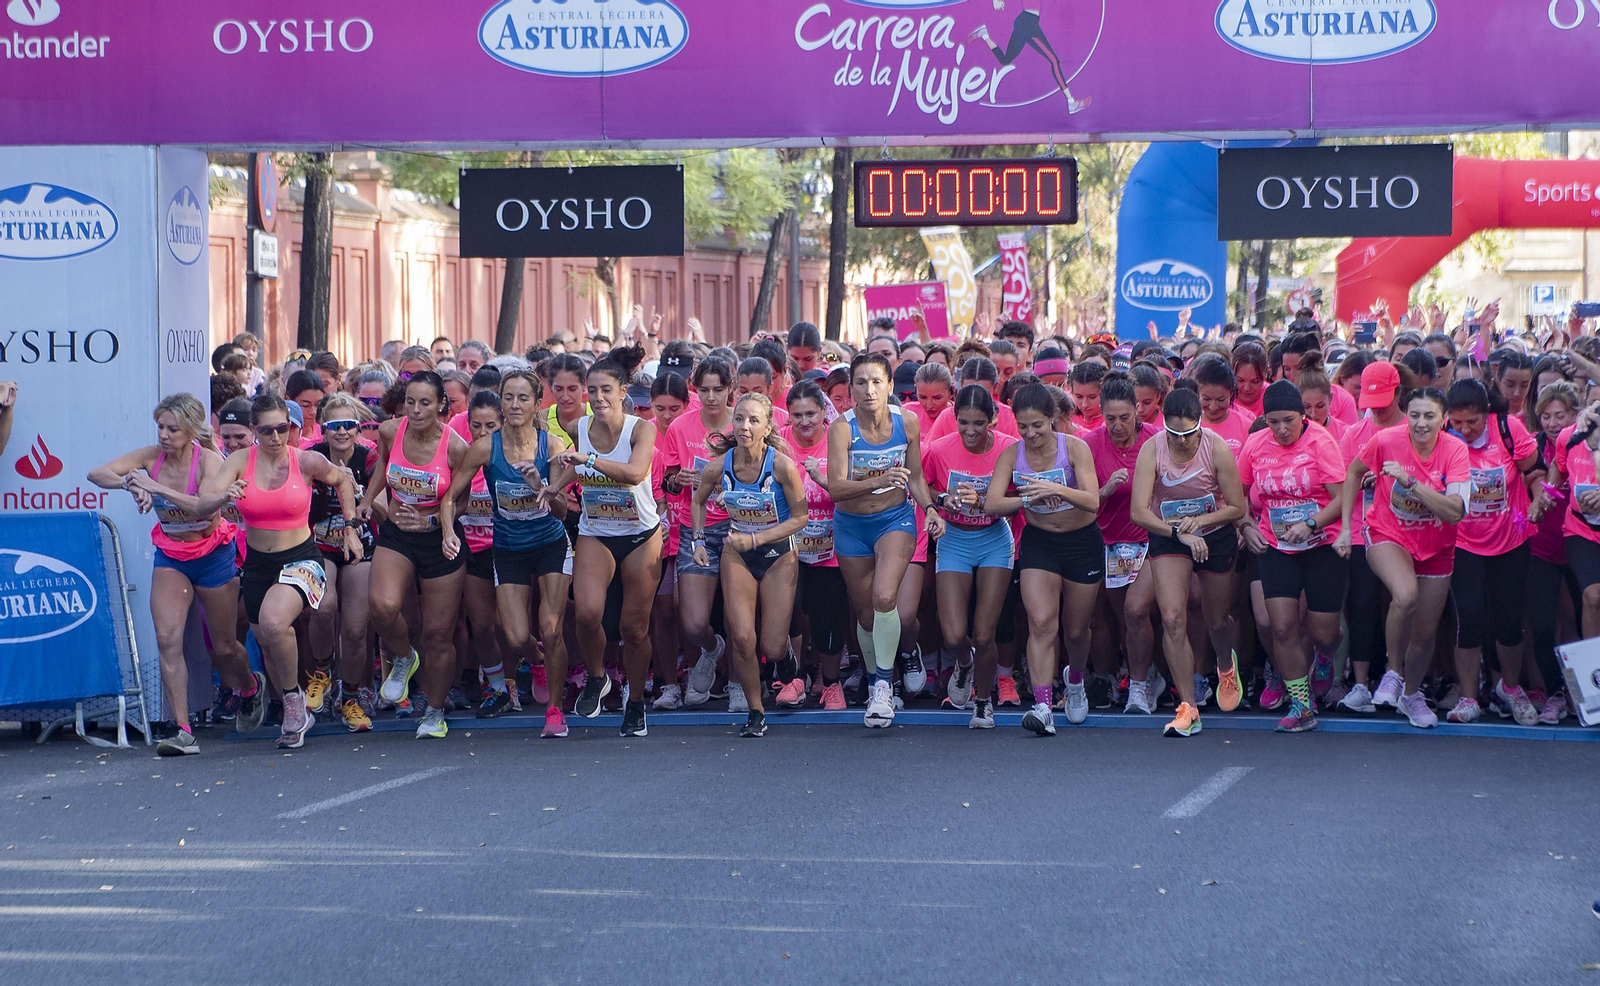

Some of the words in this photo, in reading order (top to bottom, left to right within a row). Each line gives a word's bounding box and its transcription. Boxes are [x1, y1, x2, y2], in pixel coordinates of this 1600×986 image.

[527, 12, 593, 21] CENTRAL
[600, 11, 666, 20] LECHERA
[795, 3, 955, 51] Carrera
[1233, 0, 1419, 38] ASTURIANA
[213, 18, 375, 55] OYSHO
[495, 14, 673, 51] ASTURIANA
[833, 53, 863, 87] de
[870, 52, 891, 86] la
[887, 44, 1016, 125] Mujer
[868, 166, 1062, 217] 00:00:00
[1256, 175, 1419, 210] OYSHO
[1524, 179, 1592, 207] Sports
[0, 209, 44, 218] ENTRAL
[48, 209, 101, 218] LECHERA
[495, 196, 652, 232] OYSHO
[0, 220, 107, 240] TURIANA
[170, 213, 202, 246] ASTURIANA
[1126, 277, 1207, 299] ASTURIANA
[1536, 286, 1551, 303] P
[166, 329, 205, 363] OYSHO
[400, 477, 423, 488] 016
[3, 487, 109, 510] ntander
[471, 500, 492, 508] 016
[601, 505, 623, 513] 016
[740, 509, 760, 517] 016
[803, 537, 824, 546] 016
[22, 577, 76, 589] LECHERA
